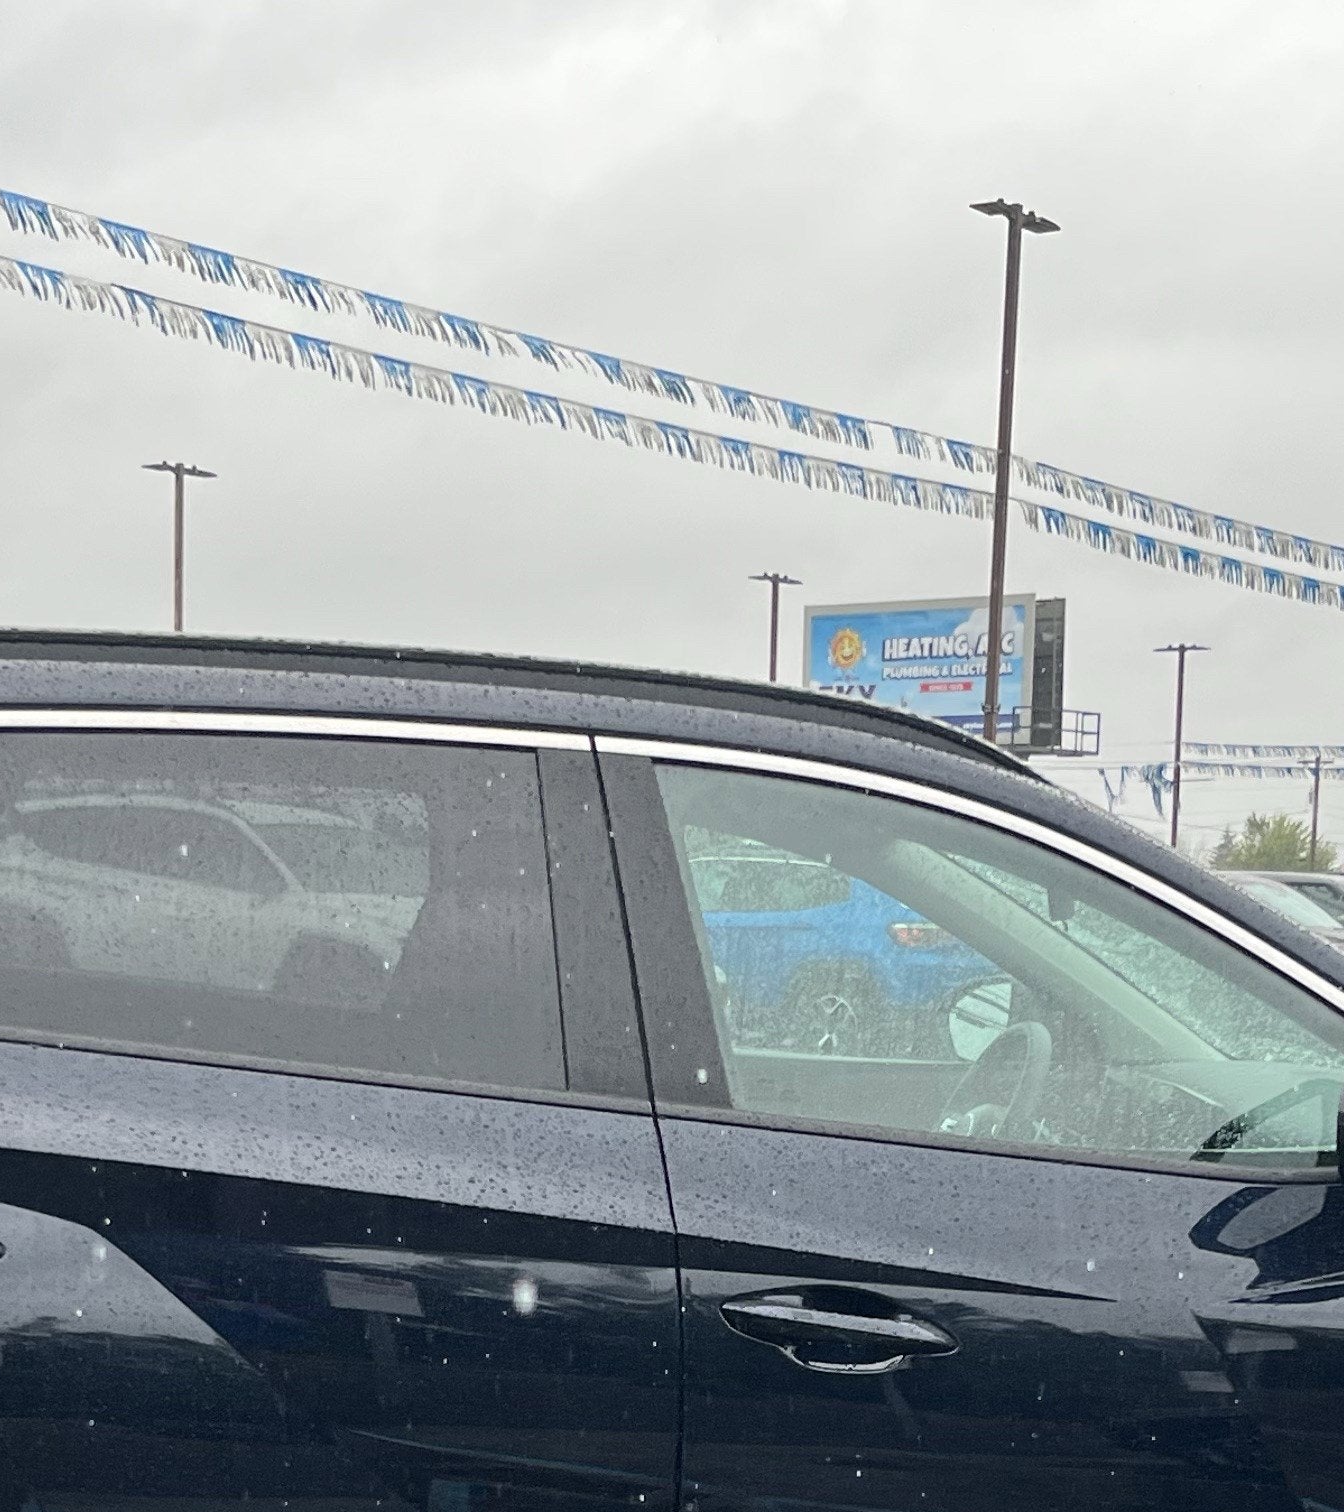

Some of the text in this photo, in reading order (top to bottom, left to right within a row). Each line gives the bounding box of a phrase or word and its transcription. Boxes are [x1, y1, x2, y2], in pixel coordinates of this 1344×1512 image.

[882, 632, 1014, 661] HEATING, AC
[882, 665, 940, 680] PLUMBING
[950, 662, 1013, 677] ELECTRAL
